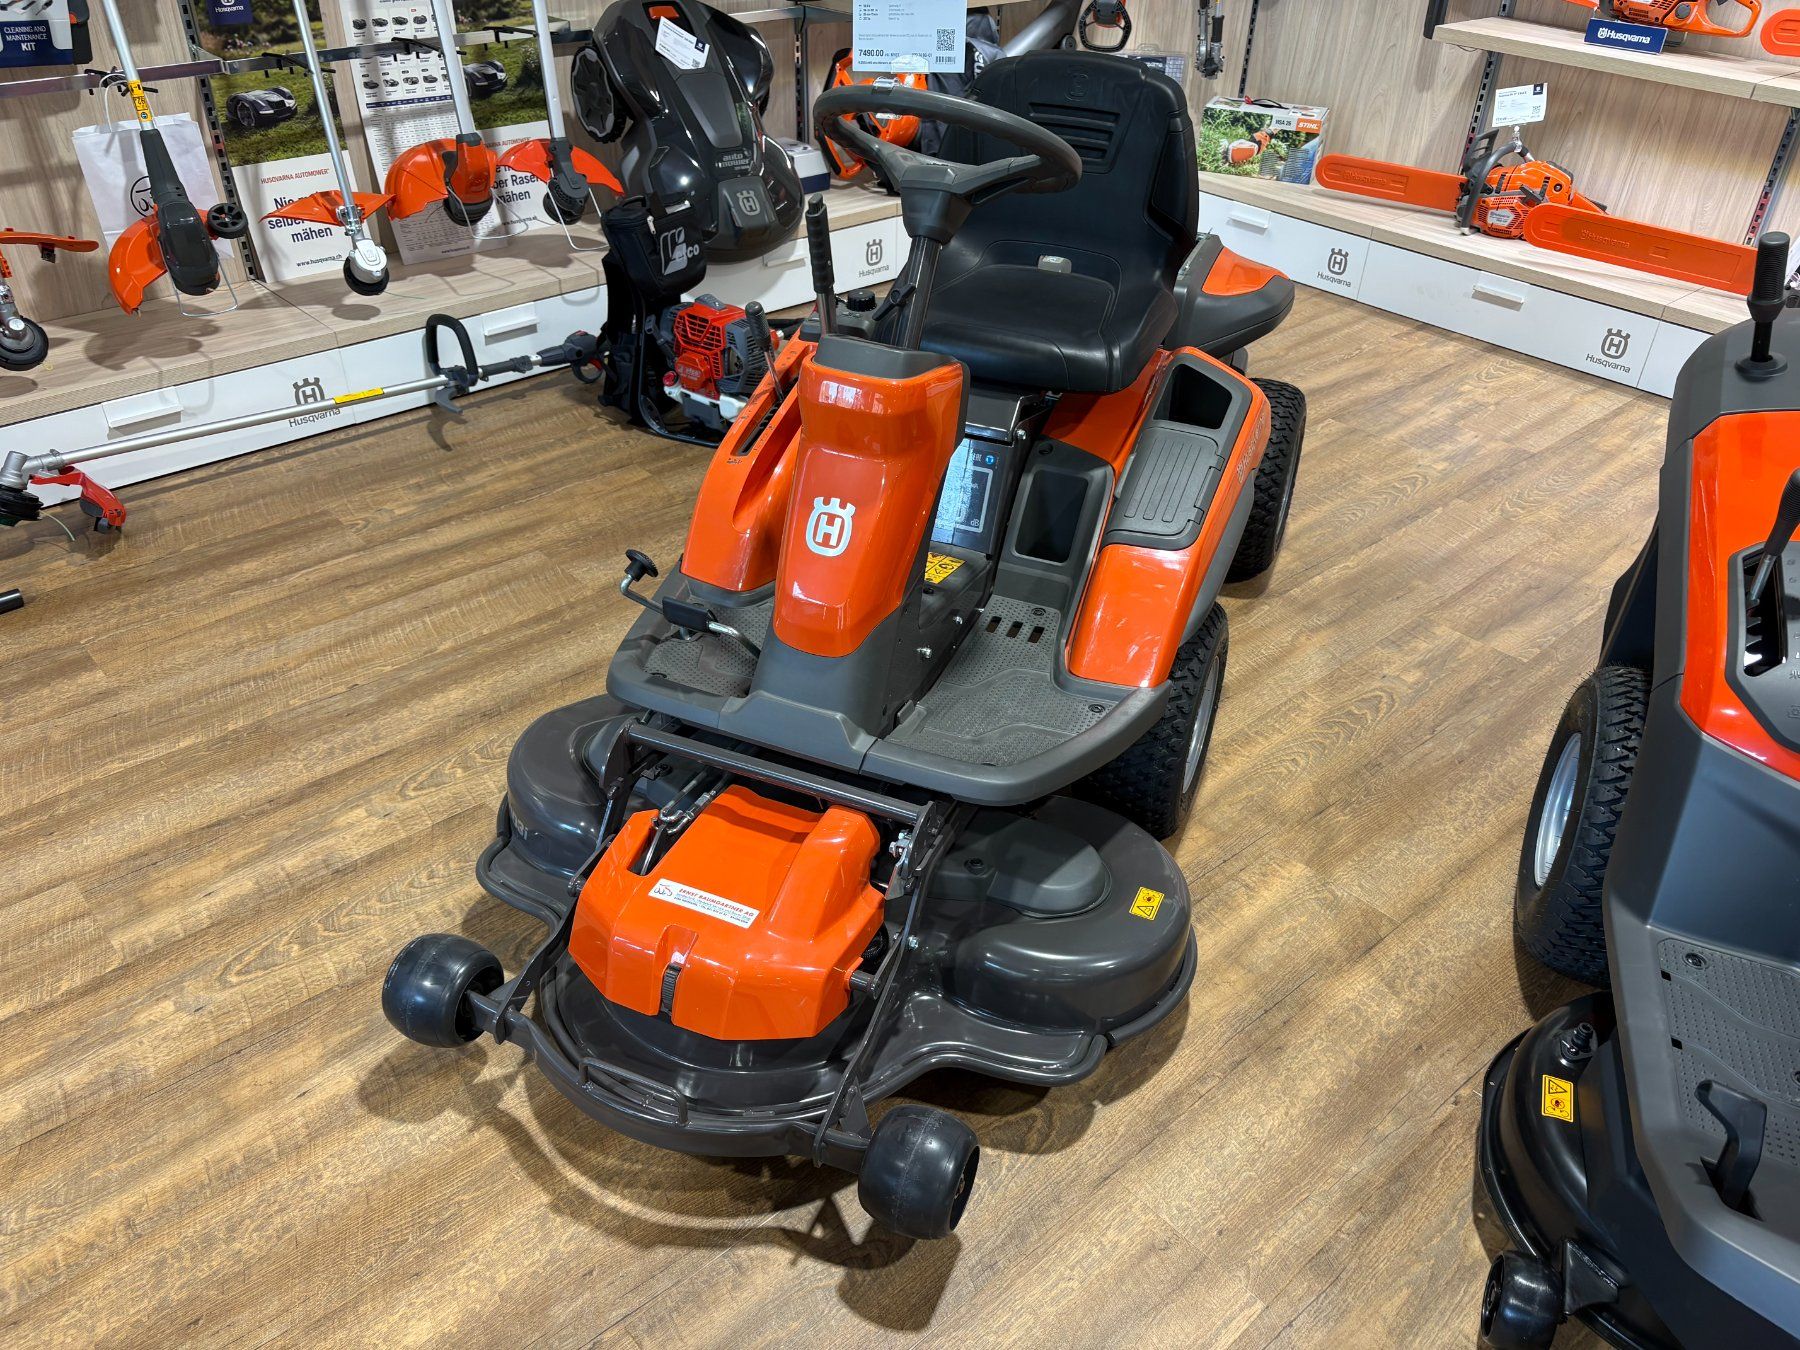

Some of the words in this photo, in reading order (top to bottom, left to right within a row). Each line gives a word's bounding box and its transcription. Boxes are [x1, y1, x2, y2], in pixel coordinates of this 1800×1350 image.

[4, 26, 33, 34] CLEANING
[34, 25, 47, 33] AND
[1607, 29, 1651, 44] Husqvarna
[6, 33, 48, 42] MAINTENANCE
[20, 42, 36, 52] KIT
[858, 49, 884, 57] 7490.00
[1298, 121, 1320, 130] STIHL
[723, 153, 744, 162] auto
[260, 173, 294, 185] HUSQVARNA
[291, 226, 334, 244] mähen
[296, 253, 343, 268] www.husqvarna.ch
[858, 264, 890, 278] Husqvarna
[1316, 271, 1351, 288] Husqvarna
[1585, 353, 1631, 374] Husqvarna
[288, 408, 341, 428] Husqvarna
[679, 888, 698, 897] ERNST
[698, 895, 743, 914] BAUMGARTNER
